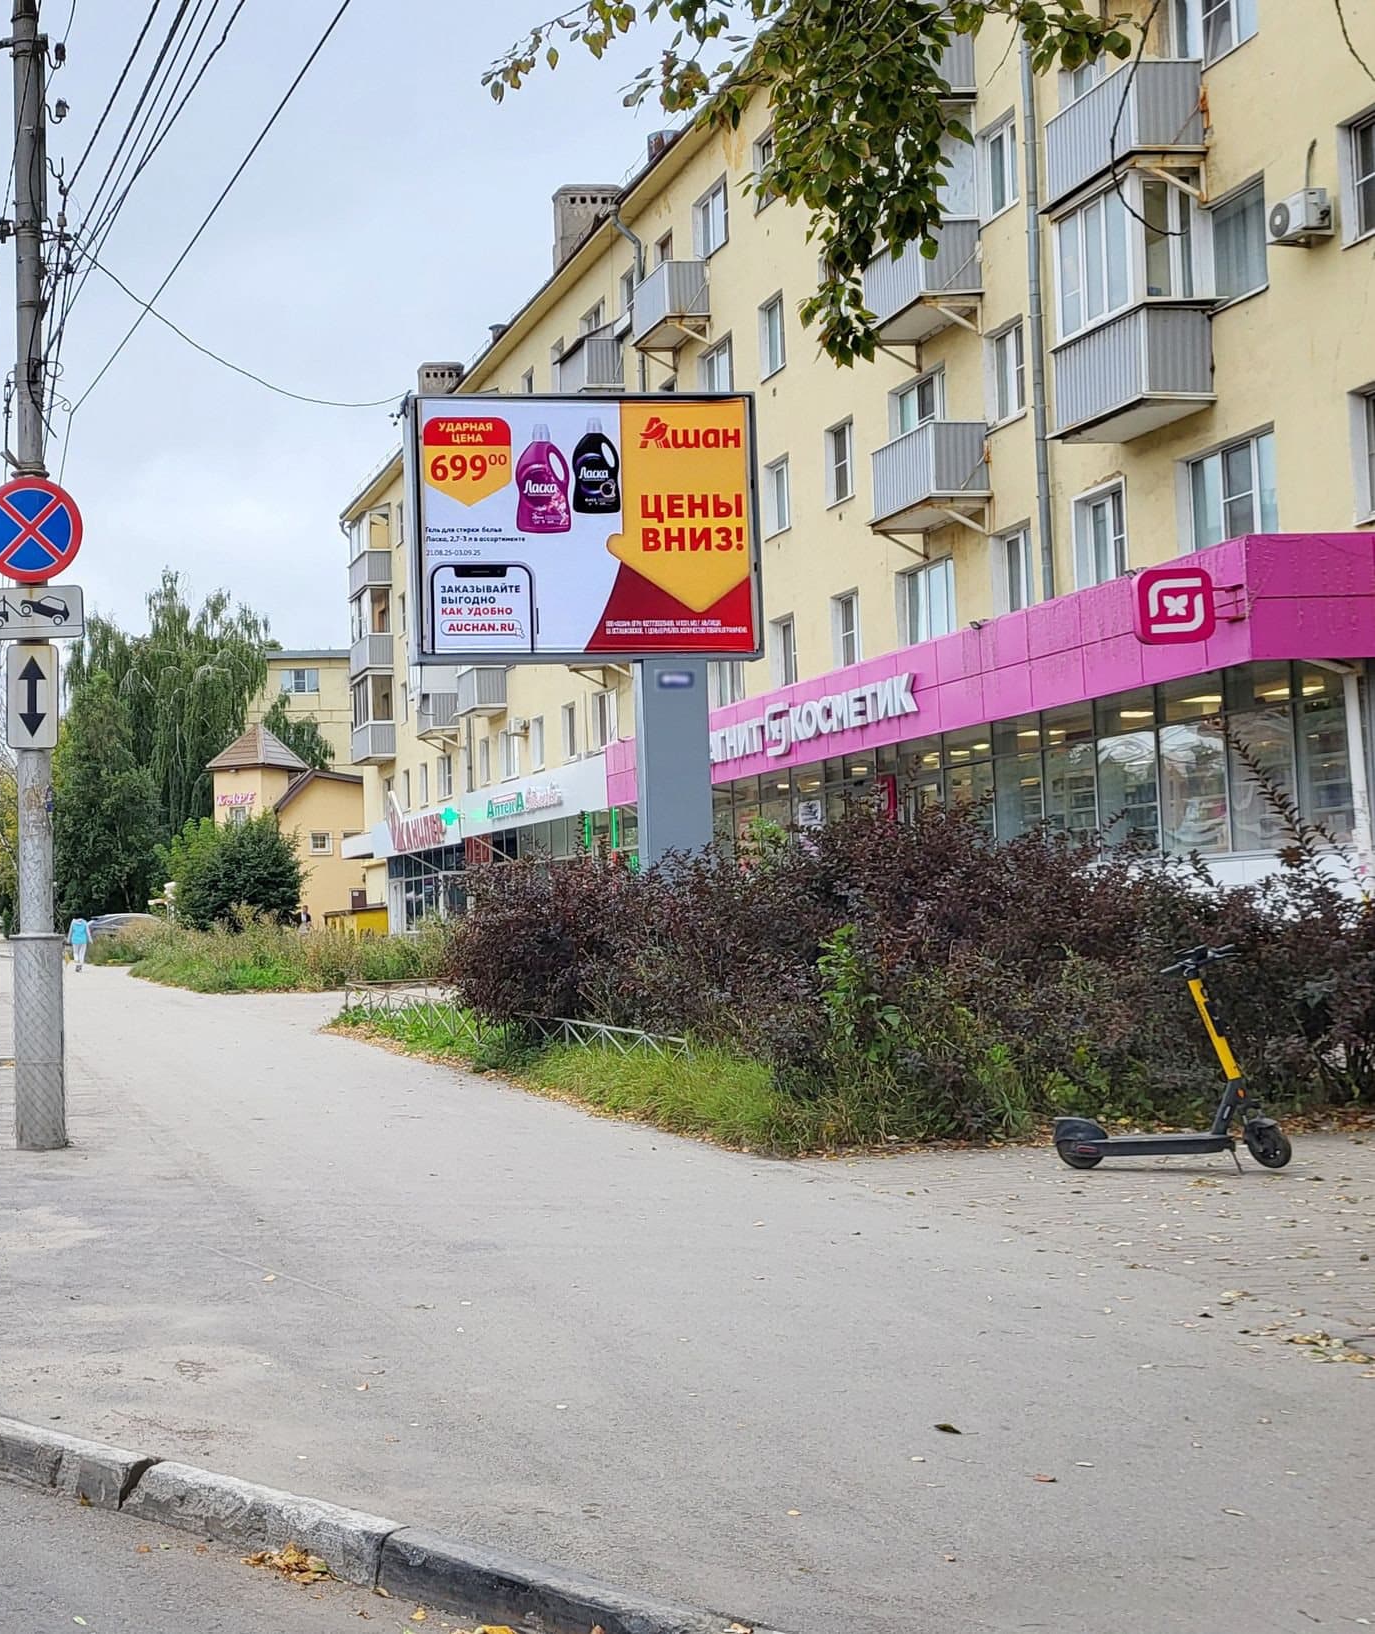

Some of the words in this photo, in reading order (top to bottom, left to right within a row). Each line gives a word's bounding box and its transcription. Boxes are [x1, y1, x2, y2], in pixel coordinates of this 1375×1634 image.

[438, 422, 493, 432] УДАРНАЯ
[639, 416, 741, 449] Ашан
[451, 433, 483, 444] ЦЕНА
[578, 466, 609, 479] Ласка
[523, 479, 557, 494] Ласка
[640, 493, 743, 523] ЦЕНЫ
[641, 526, 744, 552] ВНИЗ!
[440, 583, 521, 593] ЗАКАЗЫВАЙТЕ
[441, 596, 496, 605] ВЫГОДНО
[441, 607, 463, 616] КАК
[468, 607, 513, 616] УДОБНО
[448, 623, 515, 632] AUCHAN.RU
[710, 717, 764, 763] АГНИТ
[789, 672, 919, 743] КОСМЕТИК
